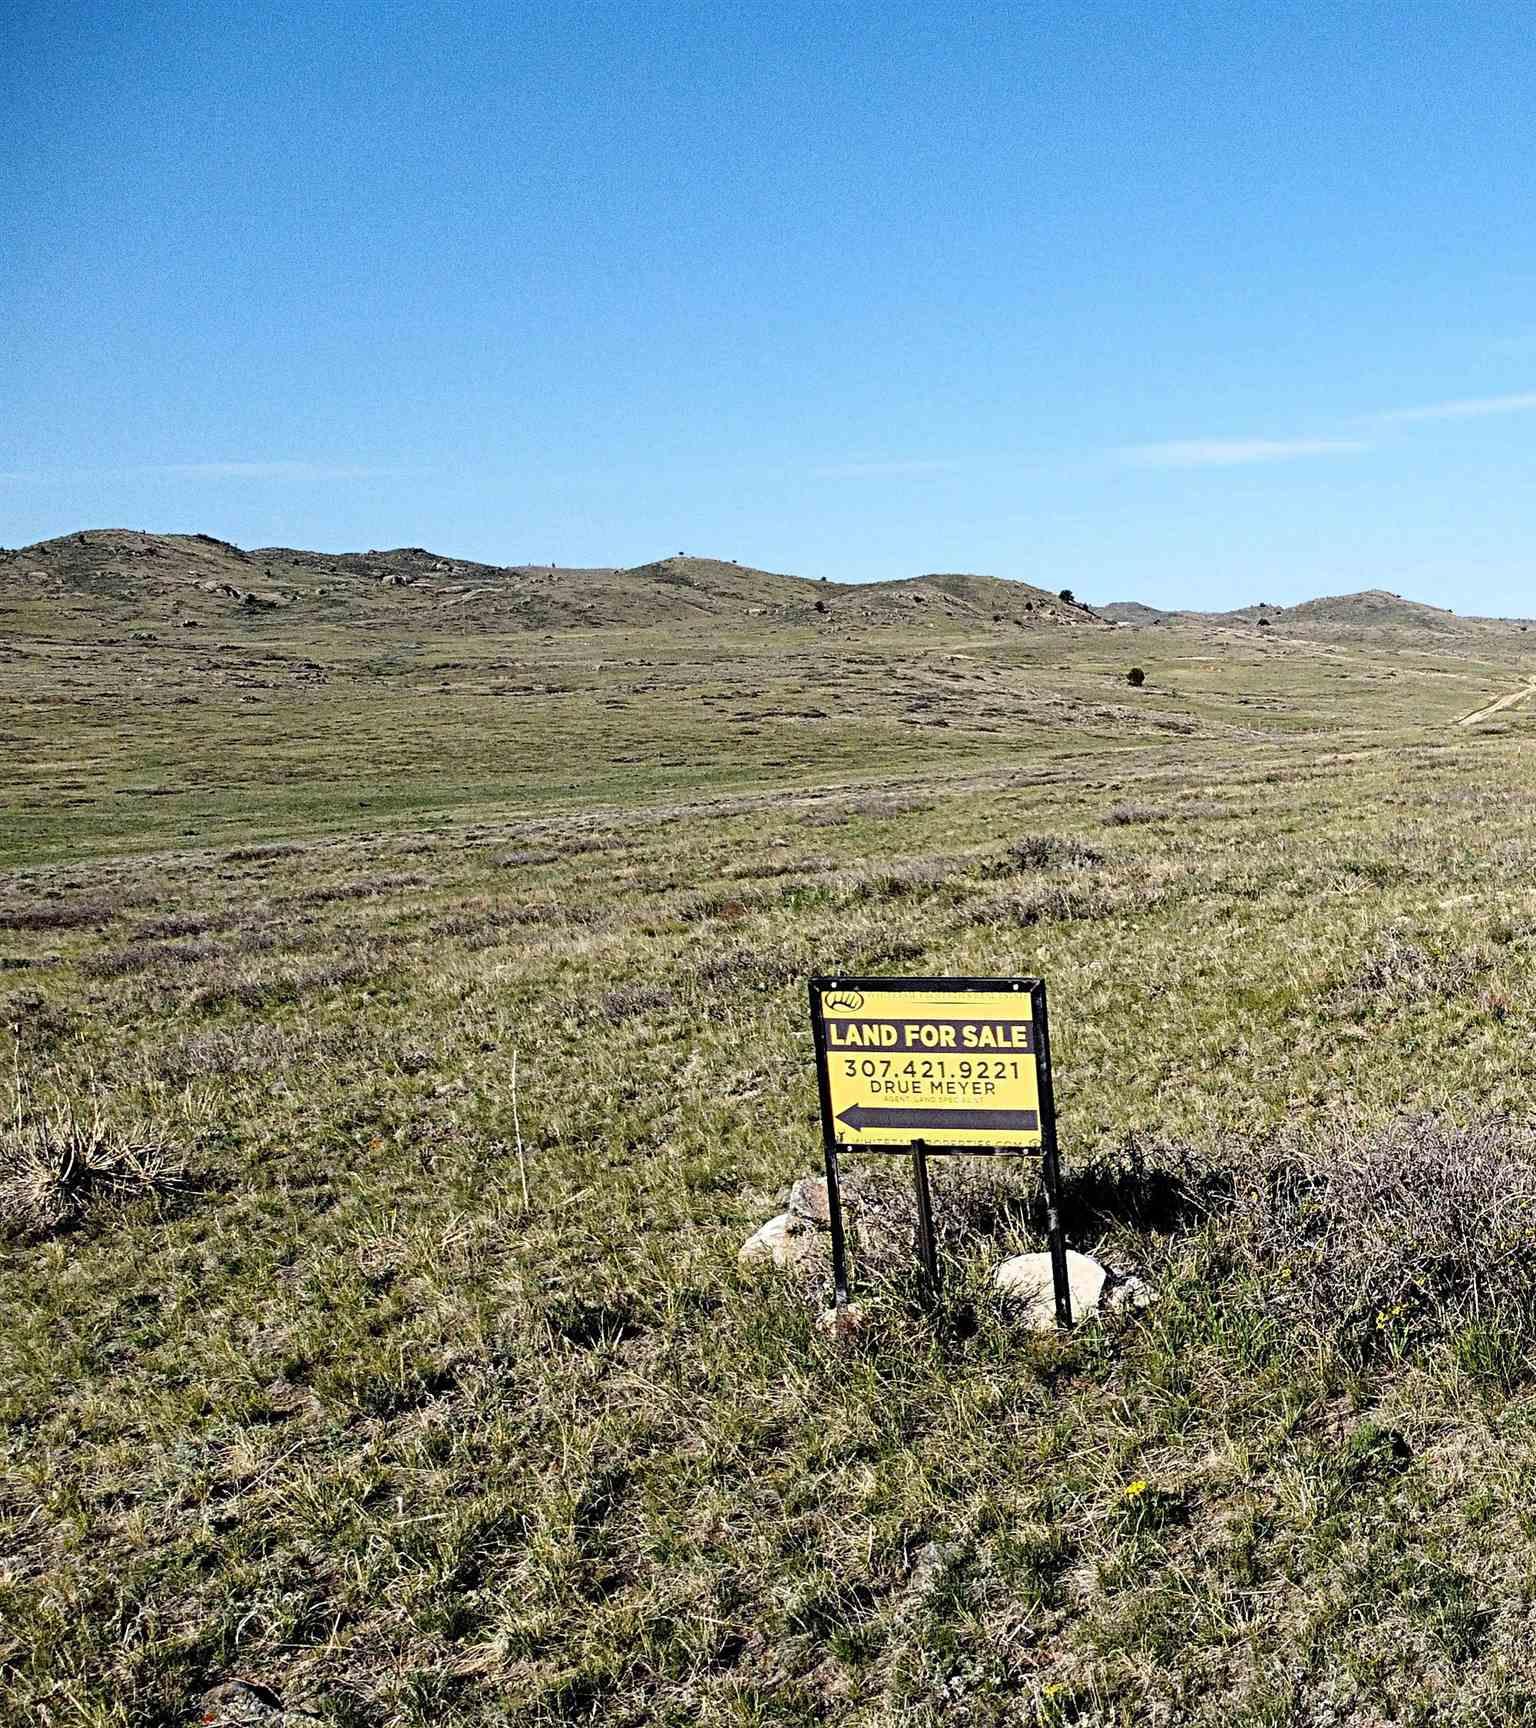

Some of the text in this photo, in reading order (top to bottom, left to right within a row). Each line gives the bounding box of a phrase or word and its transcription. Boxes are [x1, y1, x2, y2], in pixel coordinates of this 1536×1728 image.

[830, 1024, 1028, 1049] LAND FOR SALE
[844, 1059, 1020, 1080] 307.421.9221
[870, 1080, 996, 1096] DRUE MEYER
